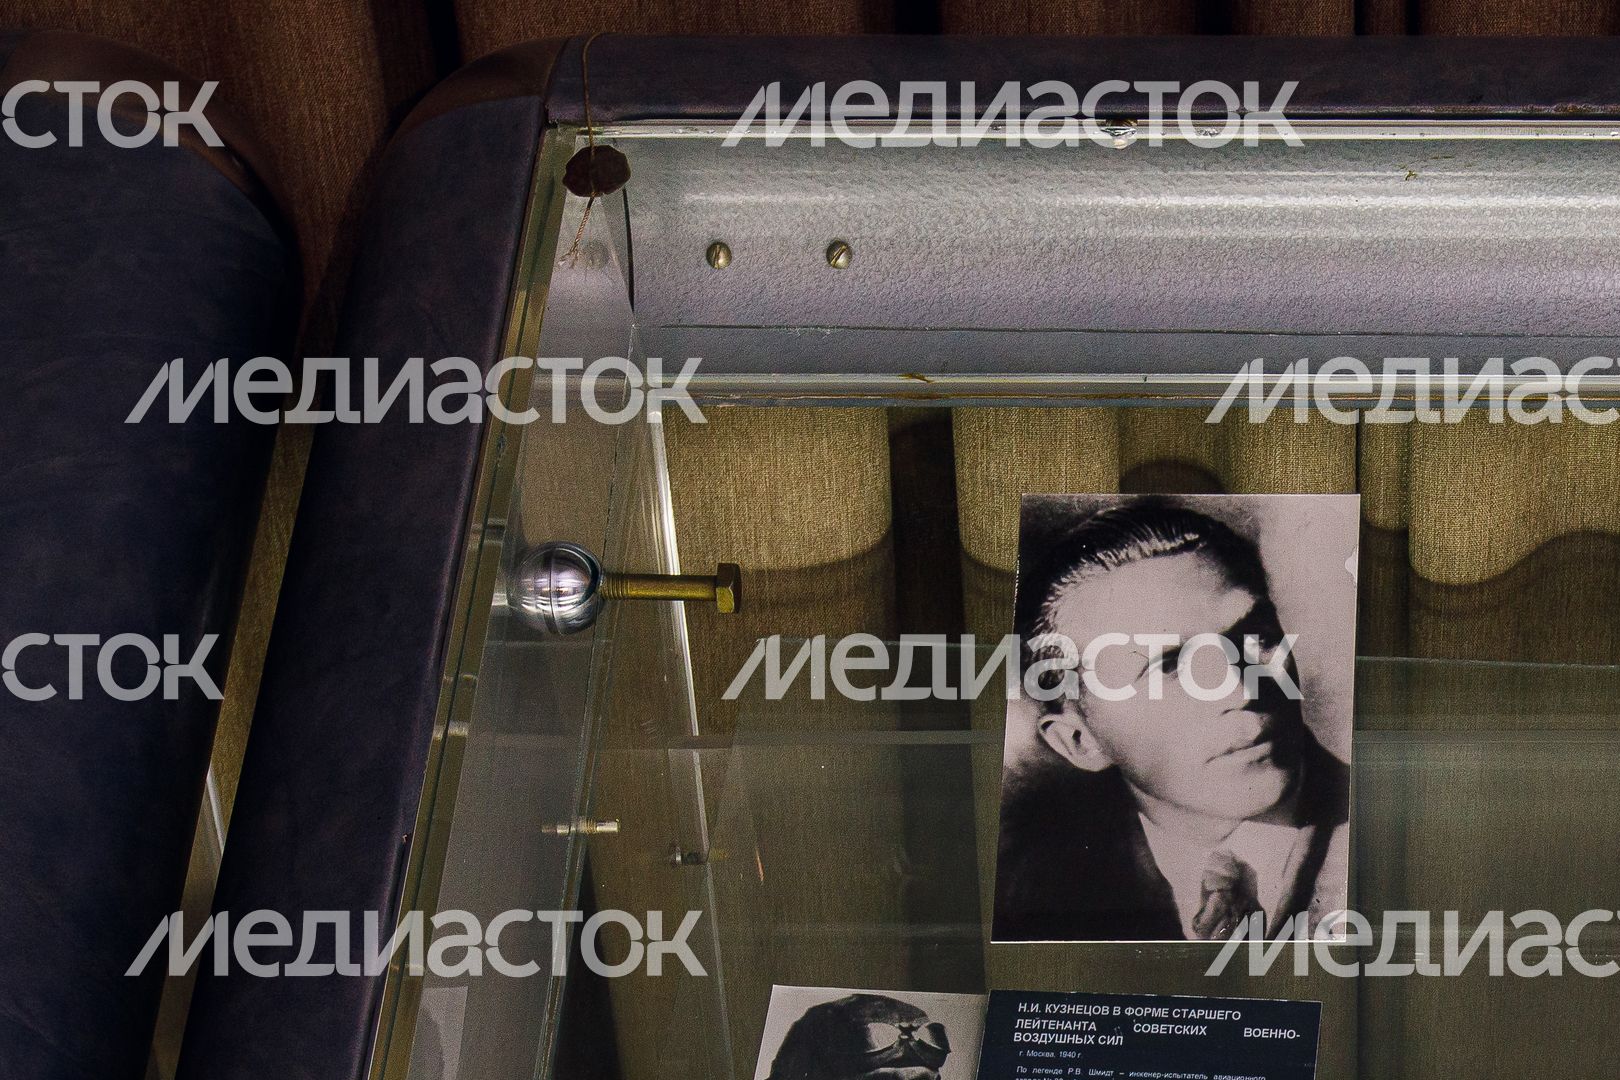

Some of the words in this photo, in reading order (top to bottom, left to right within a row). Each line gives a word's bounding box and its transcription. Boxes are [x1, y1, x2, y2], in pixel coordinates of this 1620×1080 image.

[1018, 1003, 1041, 1013] Н.И.
[1045, 1004, 1109, 1016] КУЗНЕЦОВ
[1124, 1006, 1169, 1018] ФОРМЕ
[1172, 1009, 1241, 1020] СТАРШЕГО
[1015, 1018, 1097, 1031] ЛЕЙТЕНАНТА
[1133, 1023, 1207, 1036] СОВЕТСКИХ
[1244, 1028, 1300, 1039] ВОЕННО-
[1014, 1032, 1095, 1045] ВОЗДУШНЫХ
[1098, 1035, 1123, 1045] СИЛ
